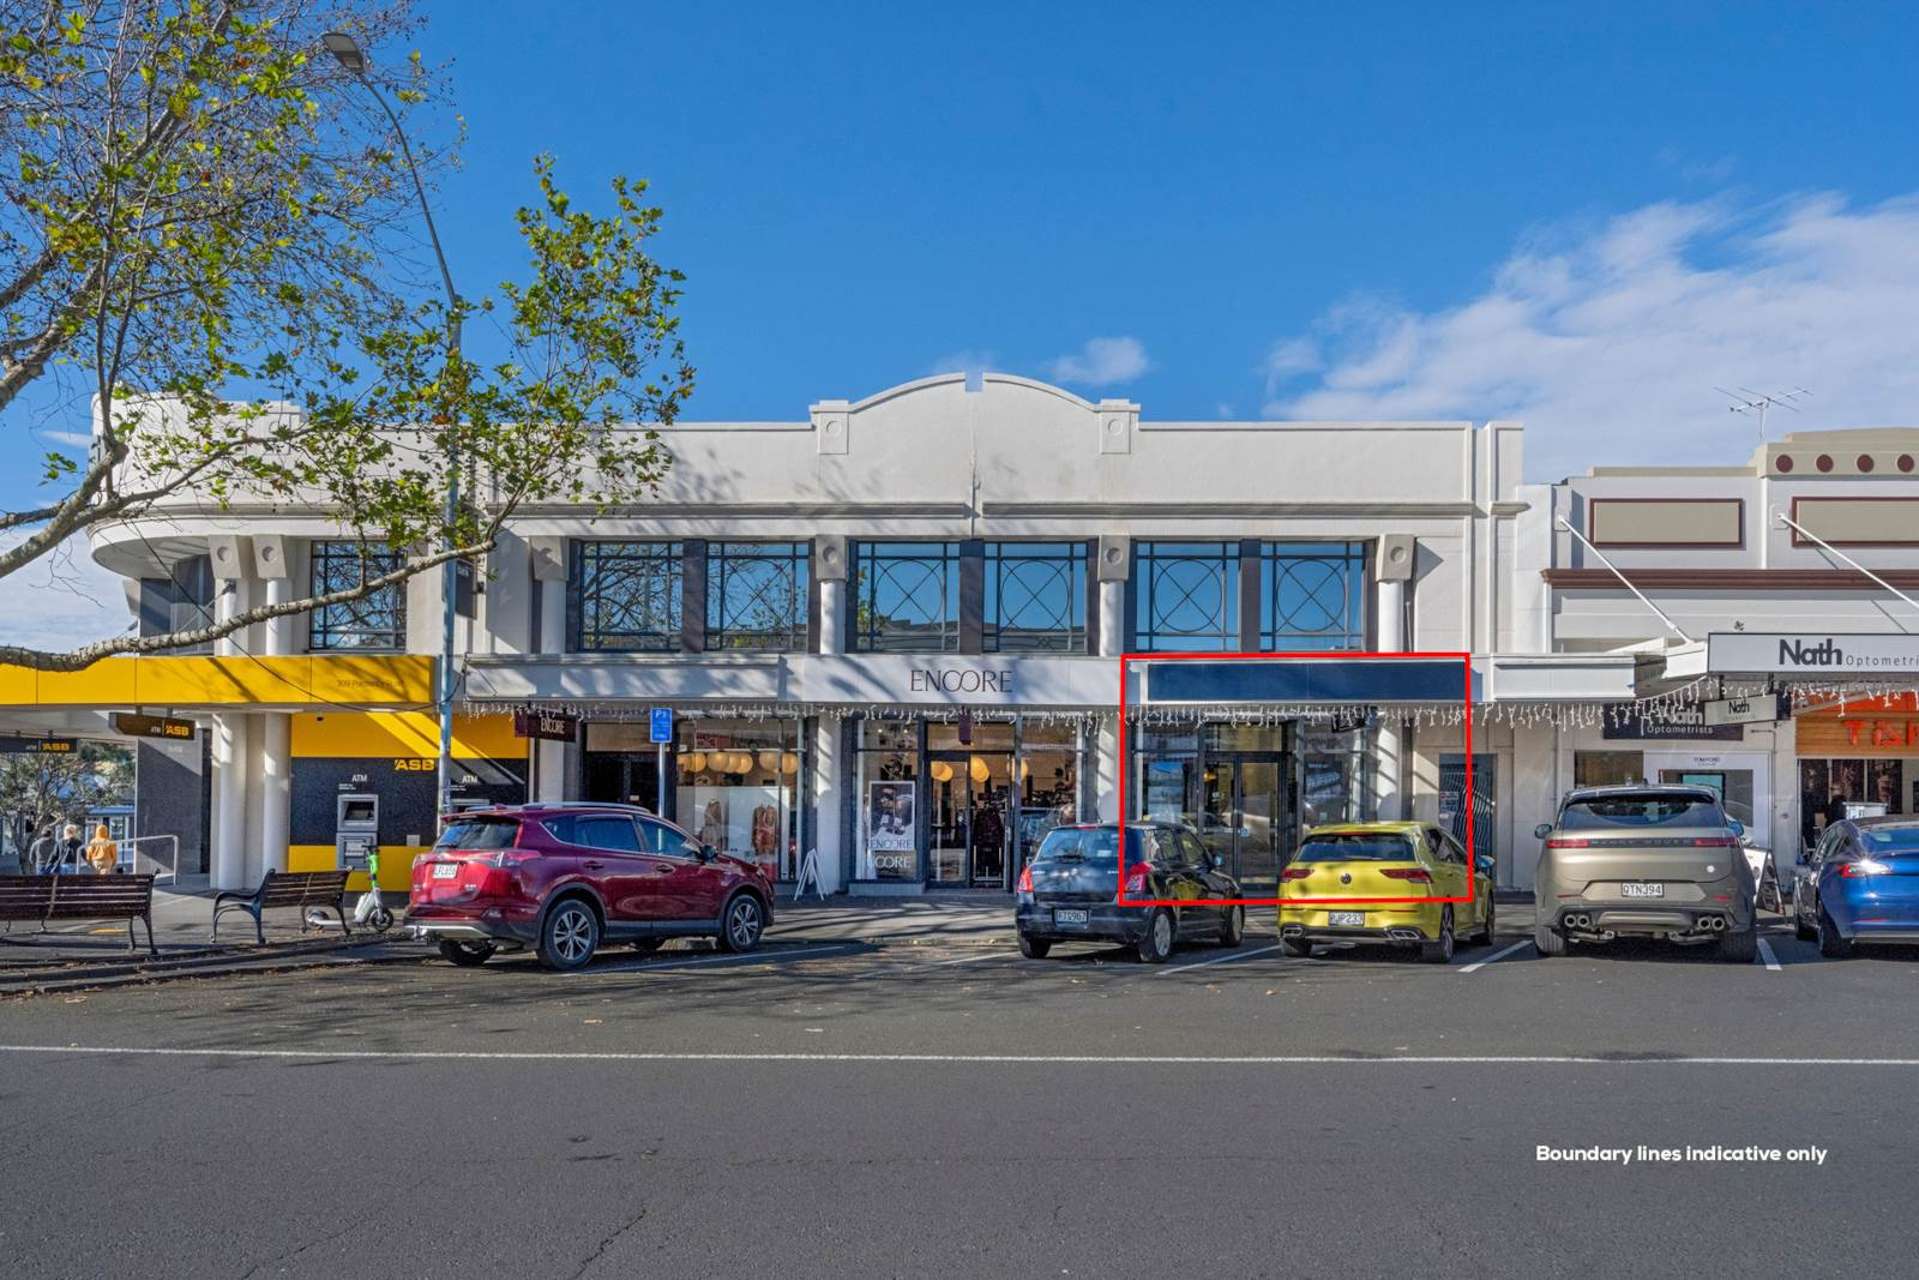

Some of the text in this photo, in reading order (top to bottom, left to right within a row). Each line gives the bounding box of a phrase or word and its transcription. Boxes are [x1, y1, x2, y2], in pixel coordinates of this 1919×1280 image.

[1779, 638, 1842, 666] Nath
[910, 669, 1013, 693] ENCORE
[1728, 699, 1750, 715] Nath
[165, 725, 189, 737] ASB
[540, 716, 565, 735] ENCORE
[1647, 724, 1713, 735] Optometrists
[394, 759, 435, 771] ASB
[352, 774, 368, 783] ATM
[462, 775, 478, 784] ATM
